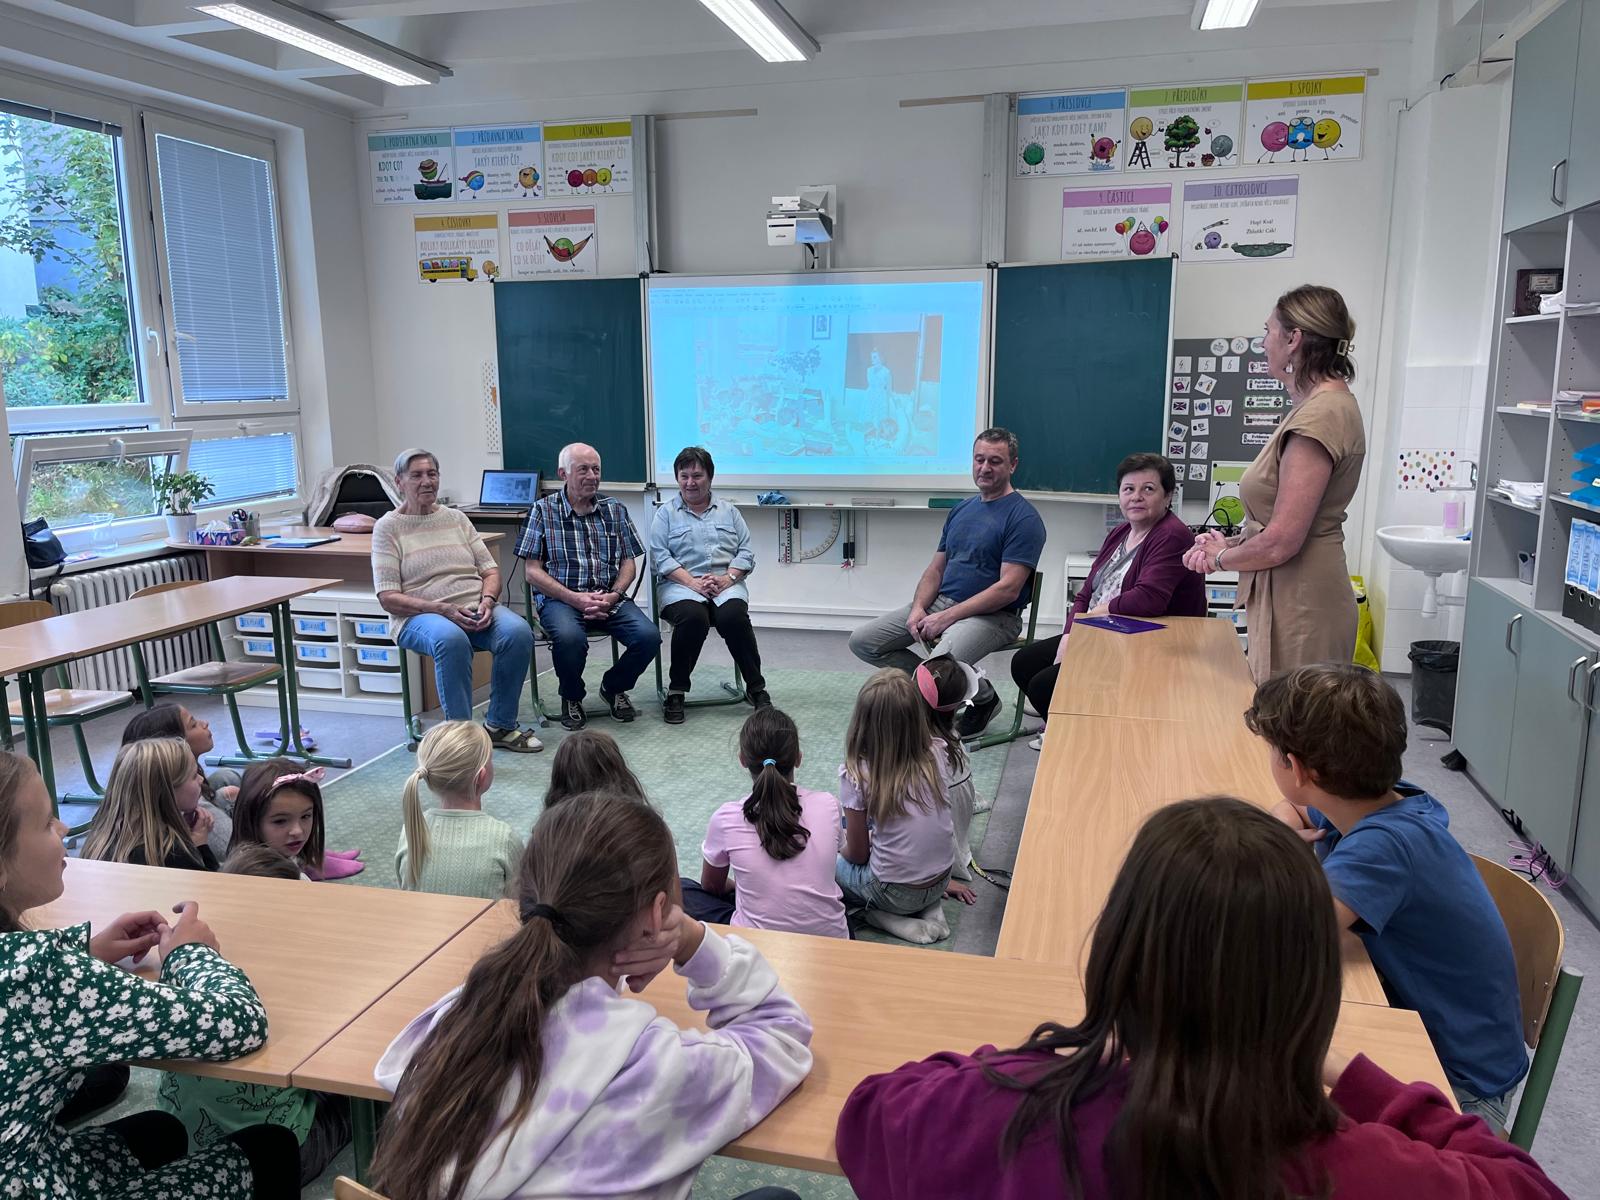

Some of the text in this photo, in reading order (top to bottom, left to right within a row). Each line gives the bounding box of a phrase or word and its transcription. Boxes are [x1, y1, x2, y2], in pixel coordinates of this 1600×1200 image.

[1298, 81, 1322, 95] SPOJKY
[1172, 88, 1208, 102] PŘEDLOŽKY
[1058, 96, 1092, 109] PŘÍSLOVCE
[1034, 122, 1107, 137] JAK? KDY? KDE? KAM?
[478, 130, 505, 142] PŘÍDAVNÁ
[379, 161, 392, 172] KDO?
[1226, 182, 1268, 196] CITOSLOVCE
[544, 212, 566, 223] SLOVESA
[1204, 360, 1209, 370] 5
[1227, 360, 1232, 370] 6
